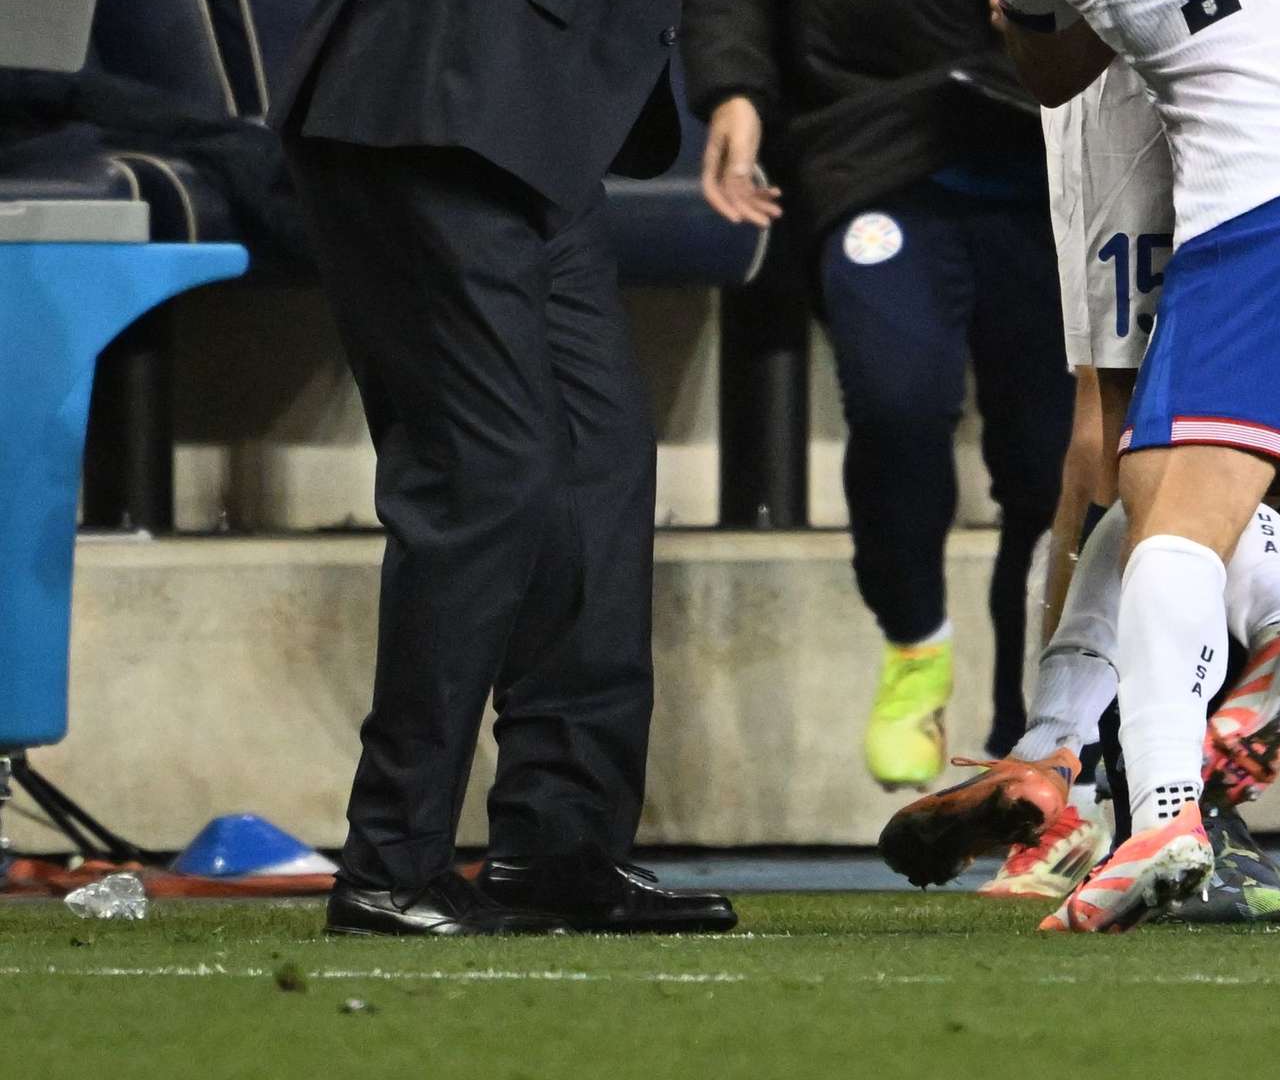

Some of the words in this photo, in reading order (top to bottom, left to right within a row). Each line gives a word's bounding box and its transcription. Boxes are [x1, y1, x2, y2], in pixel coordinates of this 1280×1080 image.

[1098, 232, 1174, 338] 15
[1257, 512, 1279, 554] USA
[1191, 644, 1215, 698] USA
